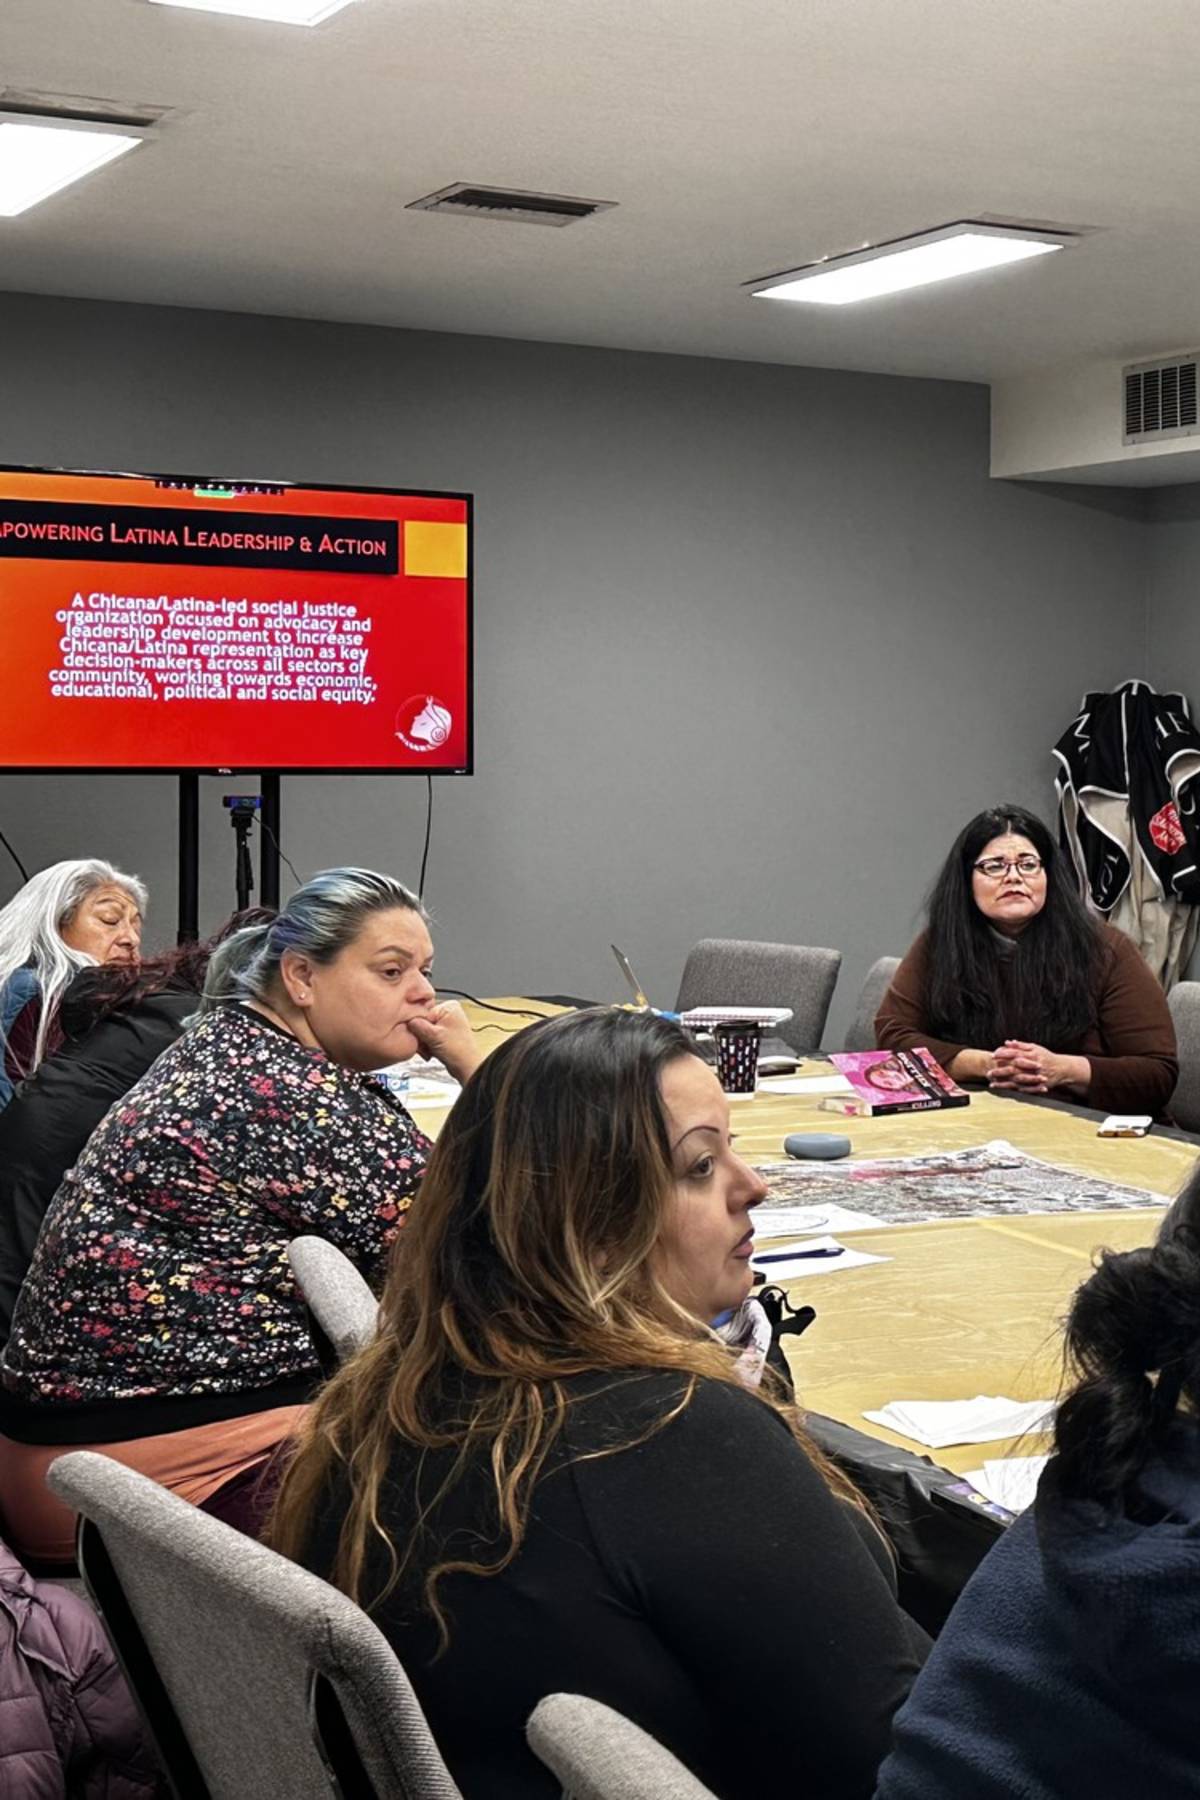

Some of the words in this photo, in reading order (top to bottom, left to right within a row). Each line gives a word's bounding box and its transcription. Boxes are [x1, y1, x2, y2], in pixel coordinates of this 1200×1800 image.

[0, 521, 104, 542] POWERING
[110, 522, 179, 546] LATINA
[183, 526, 295, 551] LEADERSHIP
[300, 537, 312, 553] &
[318, 534, 387, 556] ACTION
[72, 593, 85, 608] A
[252, 600, 298, 615] social
[303, 601, 357, 618] justice
[55, 609, 163, 626] organization
[168, 611, 234, 627] focused
[238, 616, 259, 628] on
[264, 614, 337, 632] advocacy
[342, 617, 372, 632] and
[66, 623, 156, 641] leadership
[161, 625, 269, 643] development
[274, 630, 291, 644] to
[296, 630, 364, 645] increase
[59, 637, 188, 655] Chicana/Latina
[192, 643, 314, 658] representation
[318, 647, 336, 659] as
[340, 645, 369, 662] key
[63, 652, 202, 669] decision-makers
[207, 657, 258, 671] across
[263, 656, 282, 672] all
[287, 659, 345, 673] sectors
[349, 657, 367, 674] of
[48, 669, 149, 686] community,
[155, 671, 222, 687] working
[227, 672, 291, 686] towards
[296, 673, 377, 690] economic,
[51, 683, 159, 700] educational,
[164, 684, 231, 701] political
[236, 686, 267, 700] and
[271, 686, 317, 701] social
[321, 689, 376, 704] equity.
